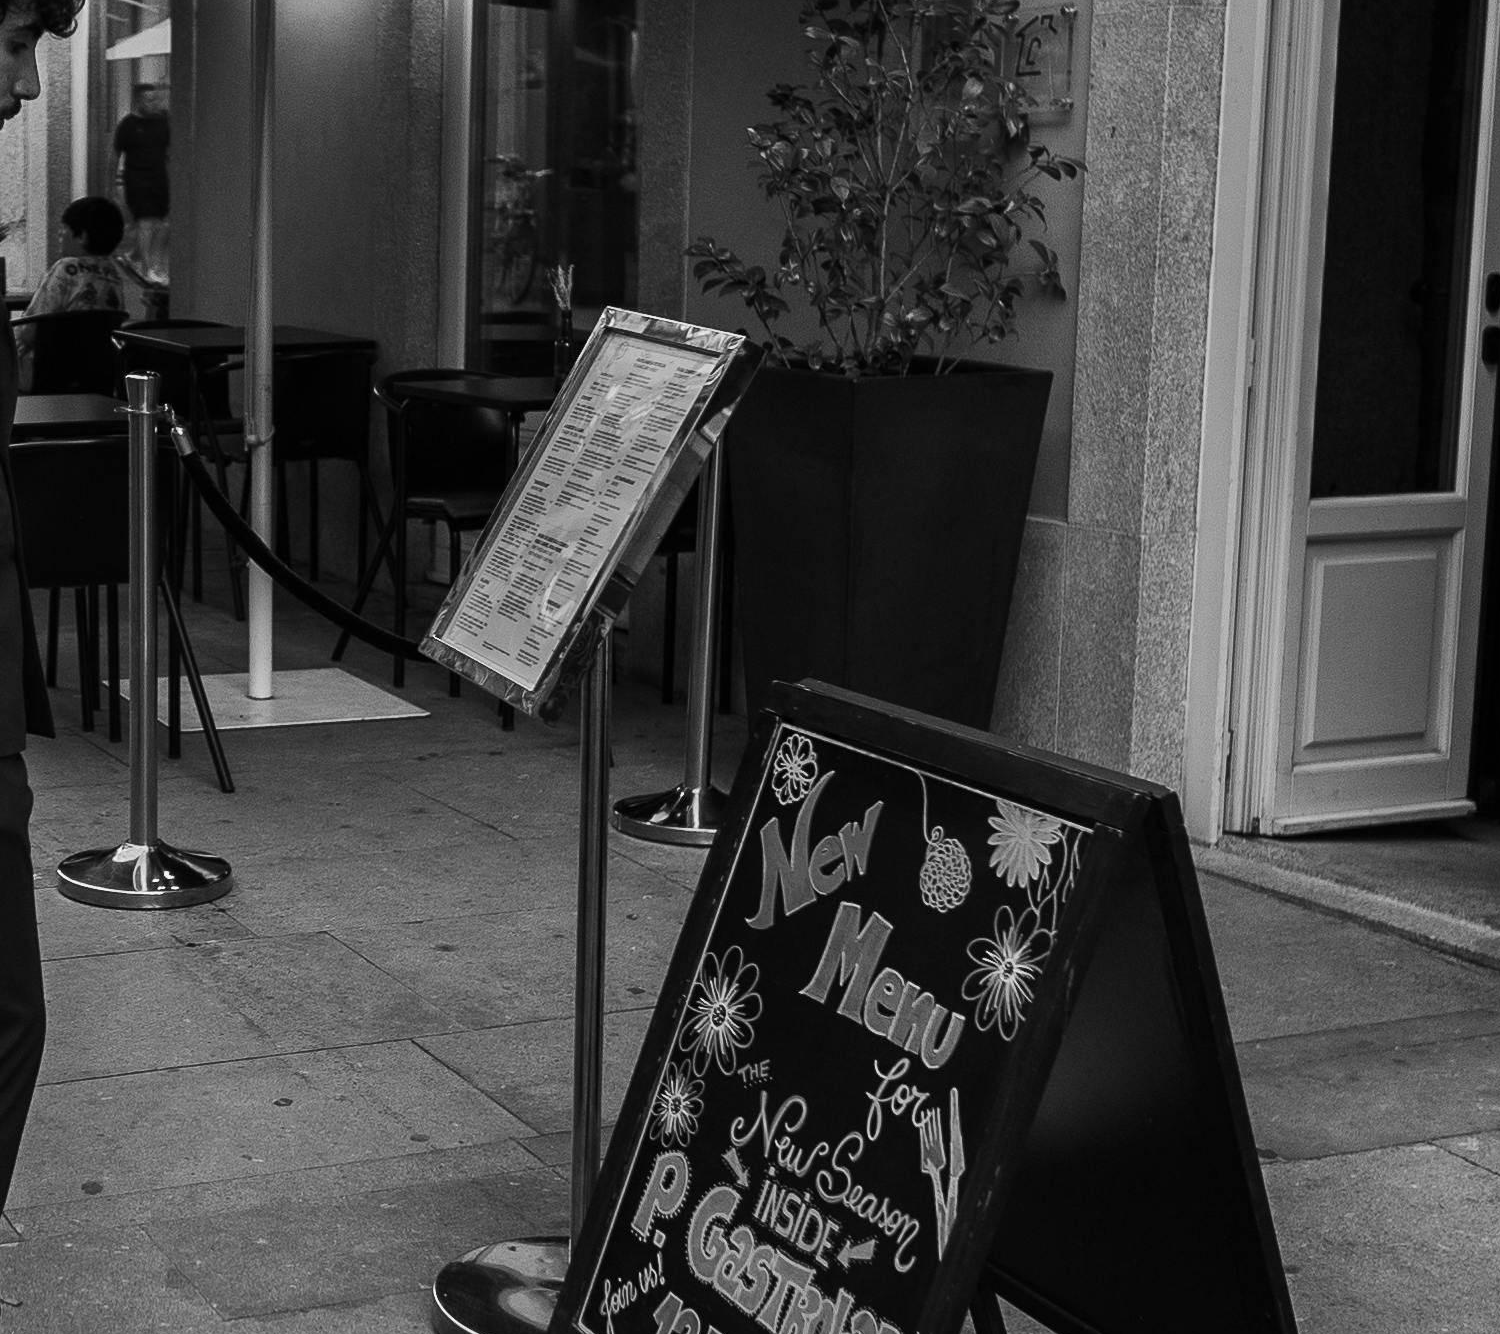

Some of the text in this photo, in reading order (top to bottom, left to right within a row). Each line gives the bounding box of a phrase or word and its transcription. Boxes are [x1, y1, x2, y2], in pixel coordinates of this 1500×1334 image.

[745, 770, 884, 930] New
[799, 901, 966, 1069] Menu
[737, 1059, 773, 1085] THE
[865, 1058, 931, 1141] for
[730, 1090, 920, 1273] New Season
[638, 1253, 666, 1295] us!
